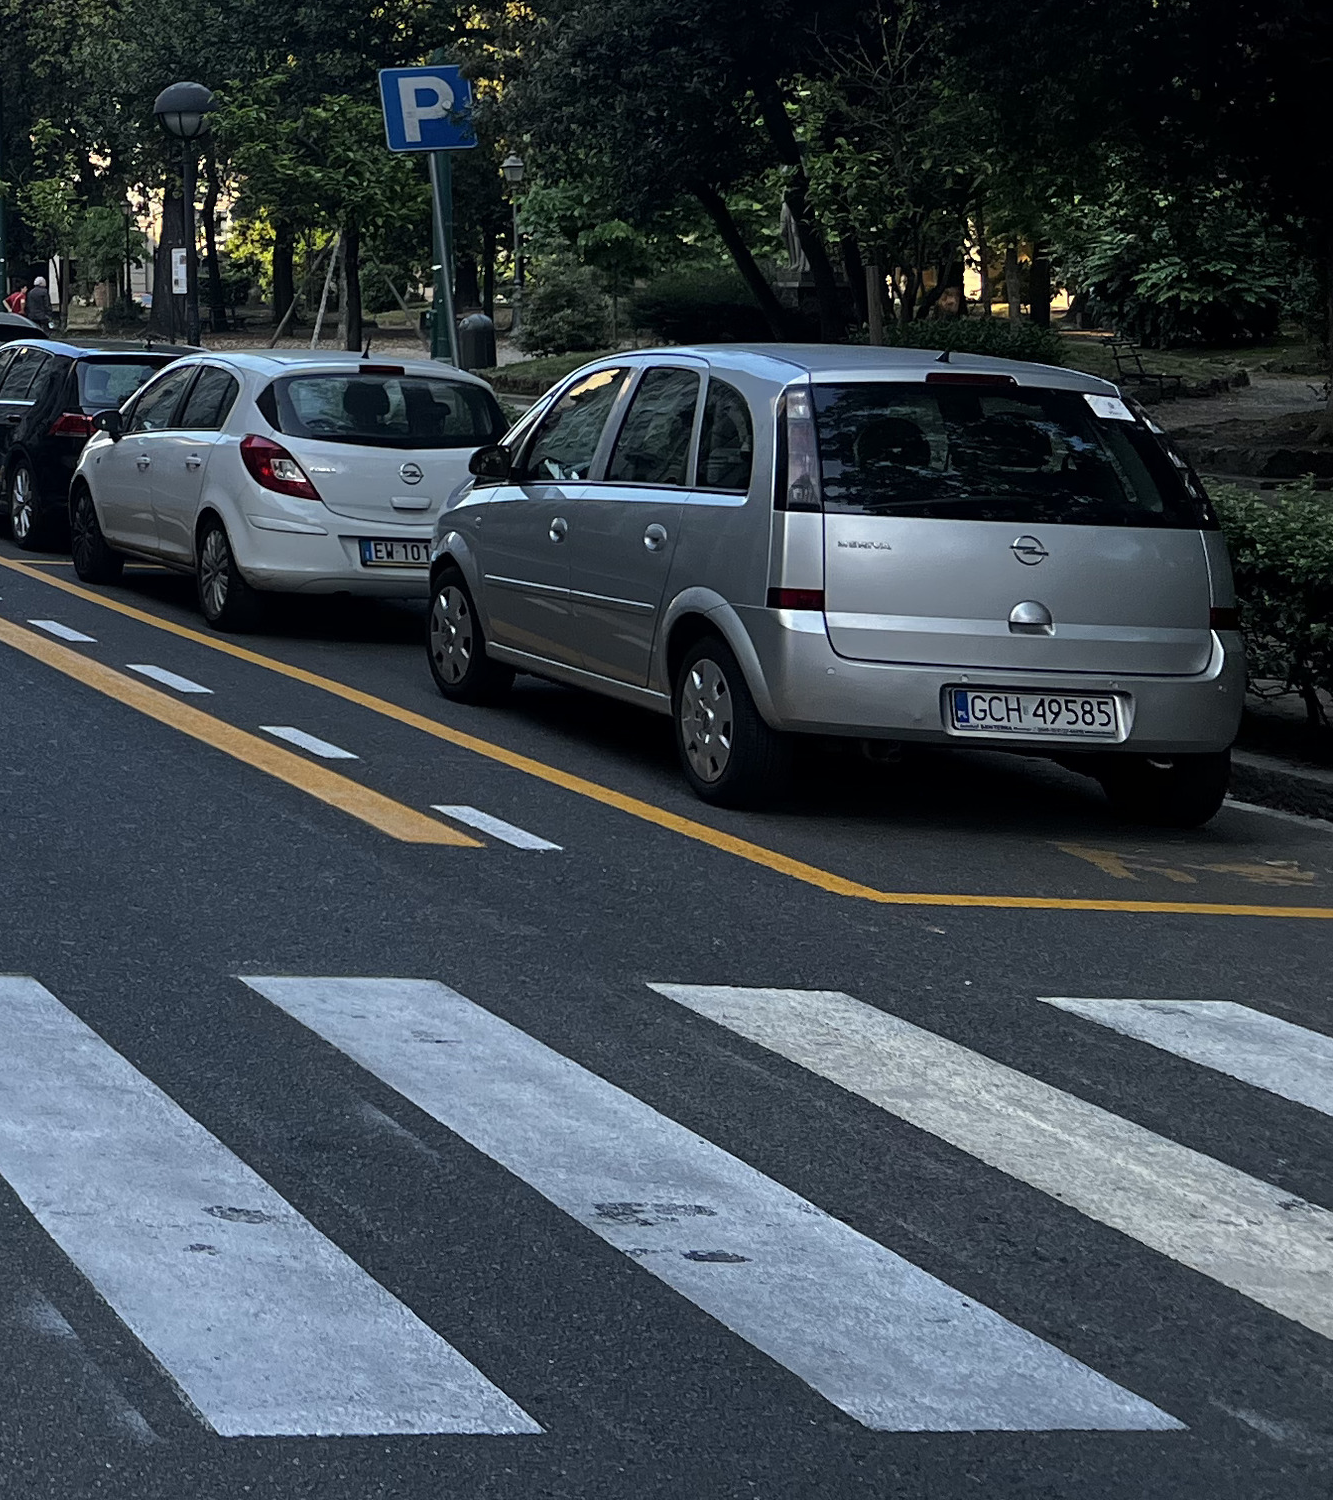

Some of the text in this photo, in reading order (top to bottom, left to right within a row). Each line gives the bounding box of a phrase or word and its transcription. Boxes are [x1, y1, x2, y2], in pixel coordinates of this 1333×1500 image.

[398, 76, 454, 142] P
[374, 542, 394, 560] EW
[971, 695, 1112, 727] GCH 49585
